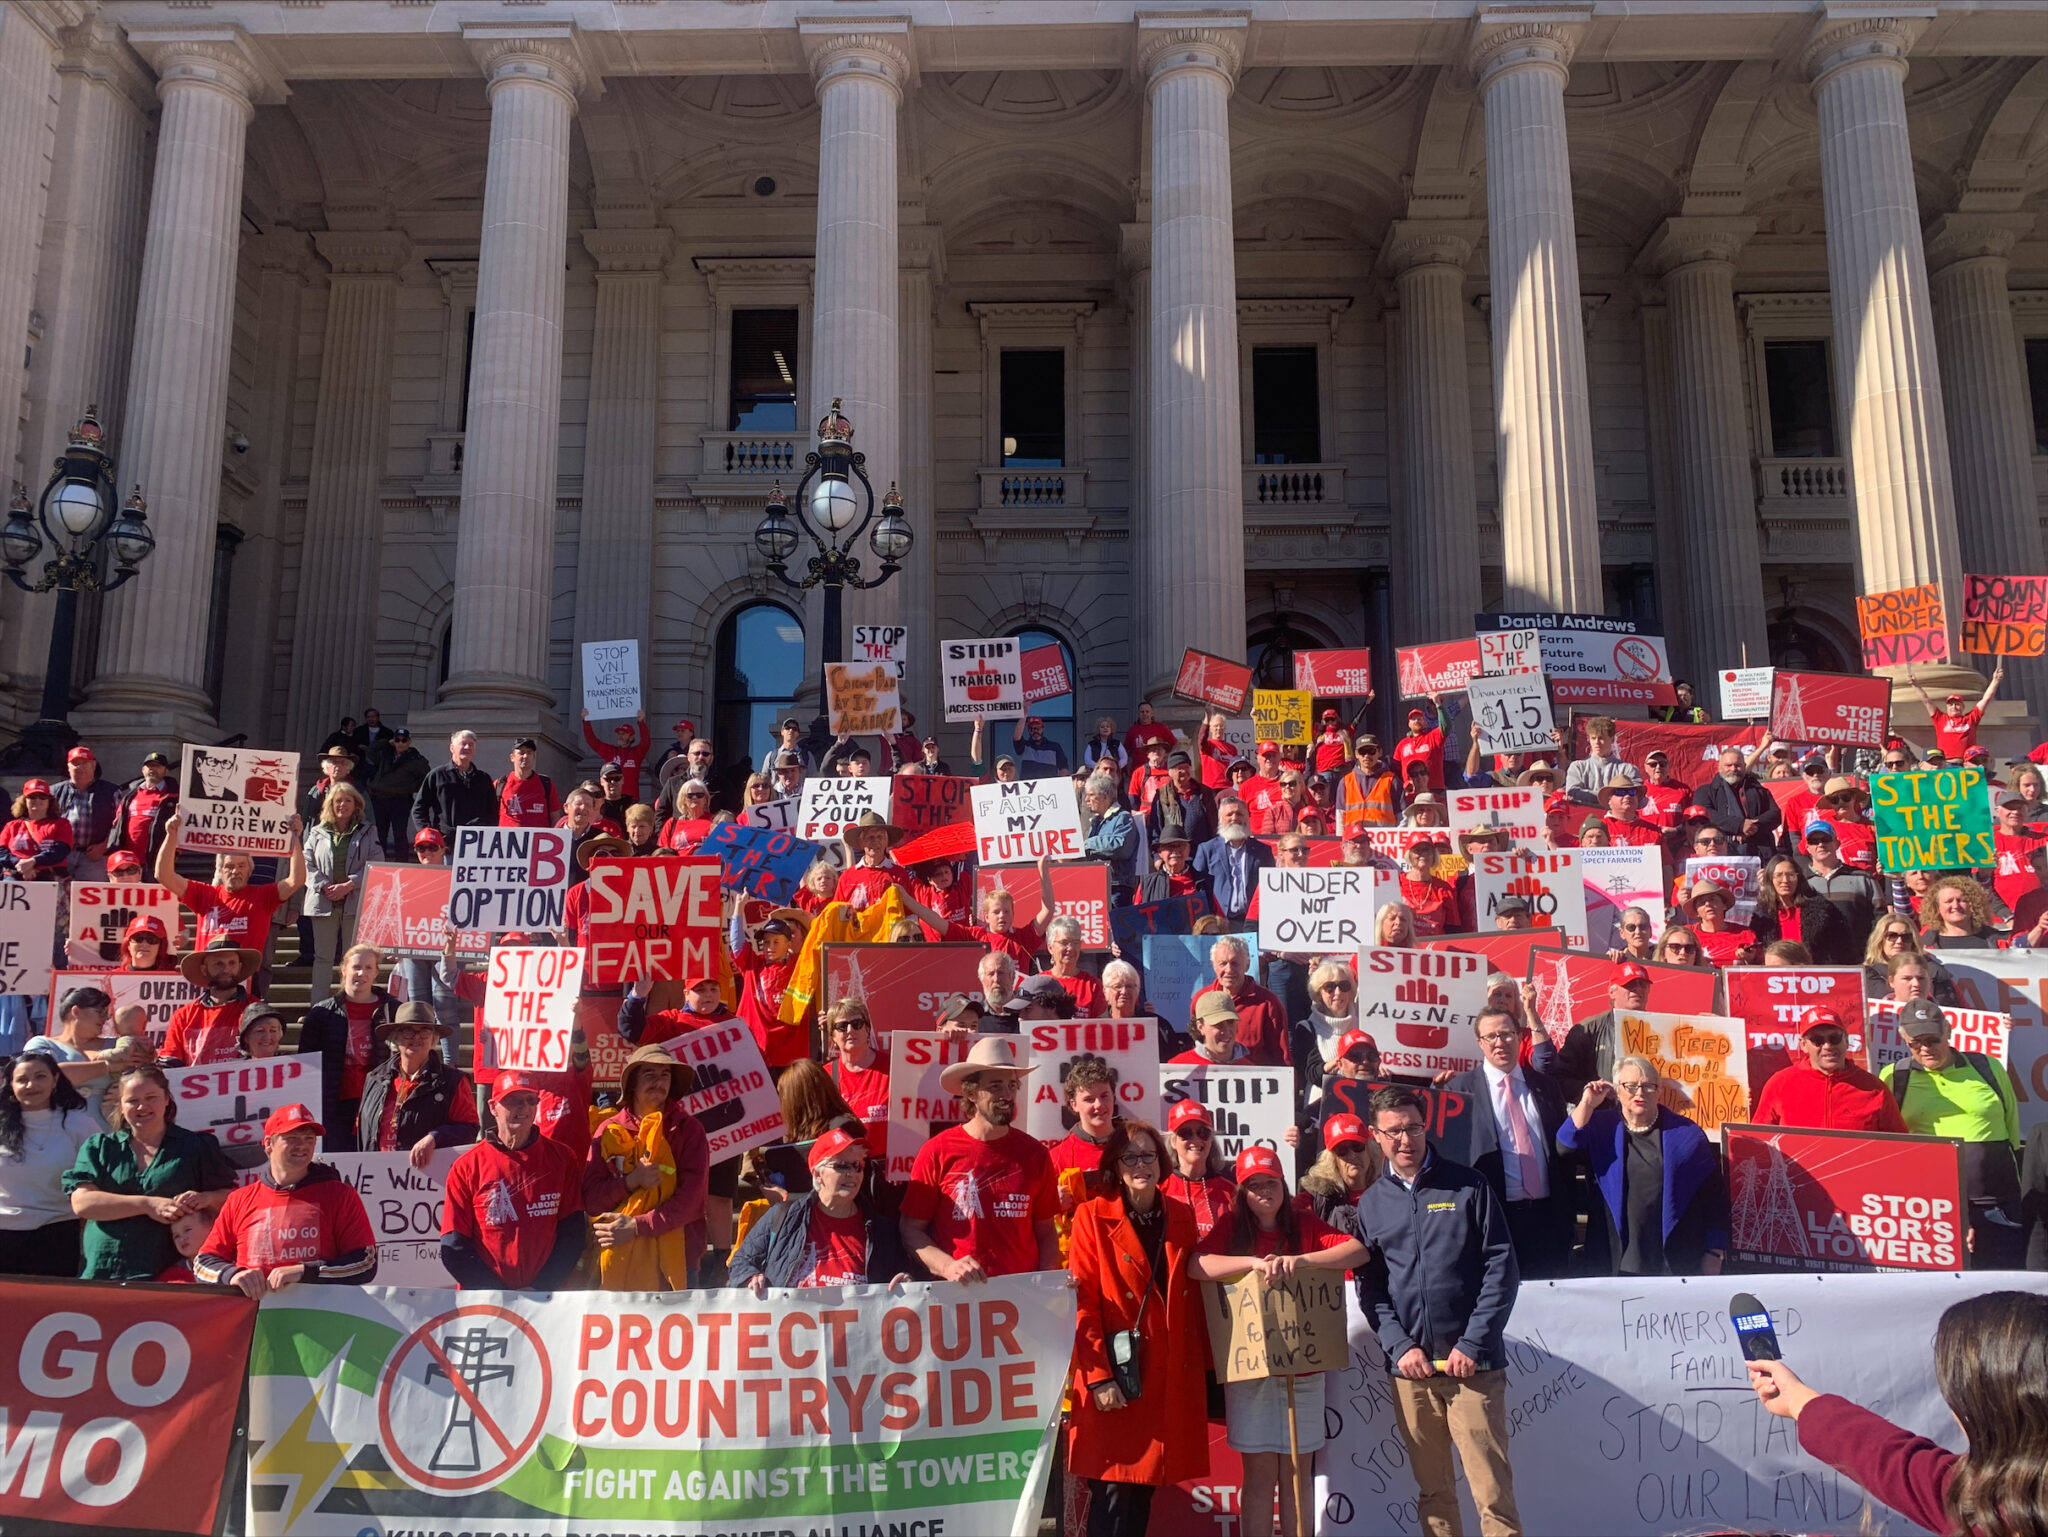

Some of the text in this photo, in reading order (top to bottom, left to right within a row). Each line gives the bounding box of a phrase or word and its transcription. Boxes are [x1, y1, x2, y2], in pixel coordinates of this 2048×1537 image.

[1866, 584, 1940, 614] DOWN
[1971, 577, 2047, 603] DOWN
[1866, 605, 1945, 633] UNDER
[1966, 598, 2048, 622] UNDER
[1499, 614, 1638, 633] Daniel Andrews
[855, 627, 905, 645] STOP
[1484, 631, 1535, 654] STOP
[1539, 634, 1574, 645] Farm
[1961, 621, 2046, 653] HVDC
[594, 646, 629, 660] STOP
[863, 644, 893, 659] THE
[949, 643, 1013, 660] STOP
[1492, 651, 1524, 667] THE
[1541, 649, 1585, 662] Future
[1864, 630, 1946, 667] HVDC
[1031, 665, 1062, 680] STOP
[1336, 669, 1367, 678] STOP
[1428, 667, 1480, 682] LABOR'S
[1447, 659, 1479, 671] STOP
[1546, 663, 1607, 674] Food Bowl
[595, 673, 629, 686] WEST
[951, 673, 1016, 688] TRANGRID
[1041, 673, 1065, 687] THE
[1318, 684, 1369, 695] TOWERS
[1343, 677, 1368, 686] THE
[587, 687, 638, 698] TRANSMISSION
[1257, 694, 1282, 706] DAN
[598, 697, 633, 710] LINES
[950, 703, 1021, 714] ACCESS DENIED
[1836, 704, 1883, 718] STOP
[1257, 708, 1278, 722] NO
[1846, 717, 1883, 732] THE
[1487, 731, 1555, 750] MILLION
[1807, 725, 1881, 744] TOWERS
[819, 779, 869, 791] OUR
[900, 777, 975, 804] STOP
[1001, 781, 1037, 797] MY
[1877, 767, 1981, 806] STOP
[212, 803, 261, 817] DAN
[811, 794, 873, 805] FARM
[979, 794, 1058, 817] FARM
[1455, 792, 1531, 811] STOP
[185, 813, 289, 834] ANDREWS
[912, 804, 958, 826] THE
[1007, 814, 1042, 832] MY
[1896, 803, 1961, 831] THE
[185, 831, 286, 850] ACCESS DENIED
[715, 825, 811, 857] STOP
[981, 828, 1080, 861] FUTURE
[1879, 832, 1994, 869] TOWERS
[457, 832, 566, 888] PLAN B
[726, 844, 782, 871] THE
[1586, 849, 1643, 857] CONSULTATION
[1607, 856, 1643, 864] FARMERS
[1483, 854, 1572, 875] STOP
[1697, 867, 1748, 881] NO GO
[456, 867, 529, 888] BETTER
[1267, 871, 1360, 896] UNDER
[79, 886, 172, 907] STOP
[591, 861, 721, 927] SAVE
[449, 889, 565, 929] OPTION
[1052, 900, 1104, 916] STOP
[1300, 898, 1336, 914] NOT
[404, 931, 487, 949] TOWRS
[635, 924, 670, 941] OUR
[1275, 918, 1363, 944] OVER
[489, 949, 579, 989] STOP
[591, 940, 711, 983] FARM
[1369, 950, 1478, 980] STOP
[1768, 976, 1836, 994] STOP
[504, 988, 550, 1025] THE
[669, 1027, 744, 1065] TOP
[1032, 1024, 1145, 1052] STOP
[1624, 1019, 1732, 1059] WE FEED
[1749, 1033, 1862, 1053] TOWS
[487, 1027, 570, 1073] TOWERS
[906, 1037, 1017, 1066] STP
[1379, 1052, 1422, 1069] CESS
[181, 1062, 302, 1099] STOP
[676, 1070, 765, 1116] RANGRID
[1035, 1082, 1144, 1104] AO
[1164, 1079, 1279, 1104] STOP
[731, 1112, 784, 1144] DENIED
[387, 1166, 438, 1192] WILL
[1008, 1193, 1031, 1202] STOP
[1861, 1193, 1953, 1220] STOP
[994, 1209, 1029, 1218] TOWERS
[278, 1226, 319, 1240] NO GO
[1807, 1210, 1955, 1243] LABOR'S
[281, 1247, 318, 1260] AEMO
[1809, 1232, 1956, 1267] TOWERS
[1246, 1320, 1316, 1344] for the
[1621, 1296, 1728, 1351] FARMERS
[1738, 1321, 1770, 1336] NEWS
[577, 1299, 1023, 1374] PROTECT OUR
[18, 1310, 192, 1408] GO
[1671, 1350, 1751, 1381] FAMIL
[571, 1360, 1038, 1441] COUNTRYSIDE
[1599, 1395, 1724, 1465] STOP
[562, 1449, 1037, 1501] FIGHT AGAINST THE TOWERS
[1636, 1468, 1866, 1524] OUR LAND
